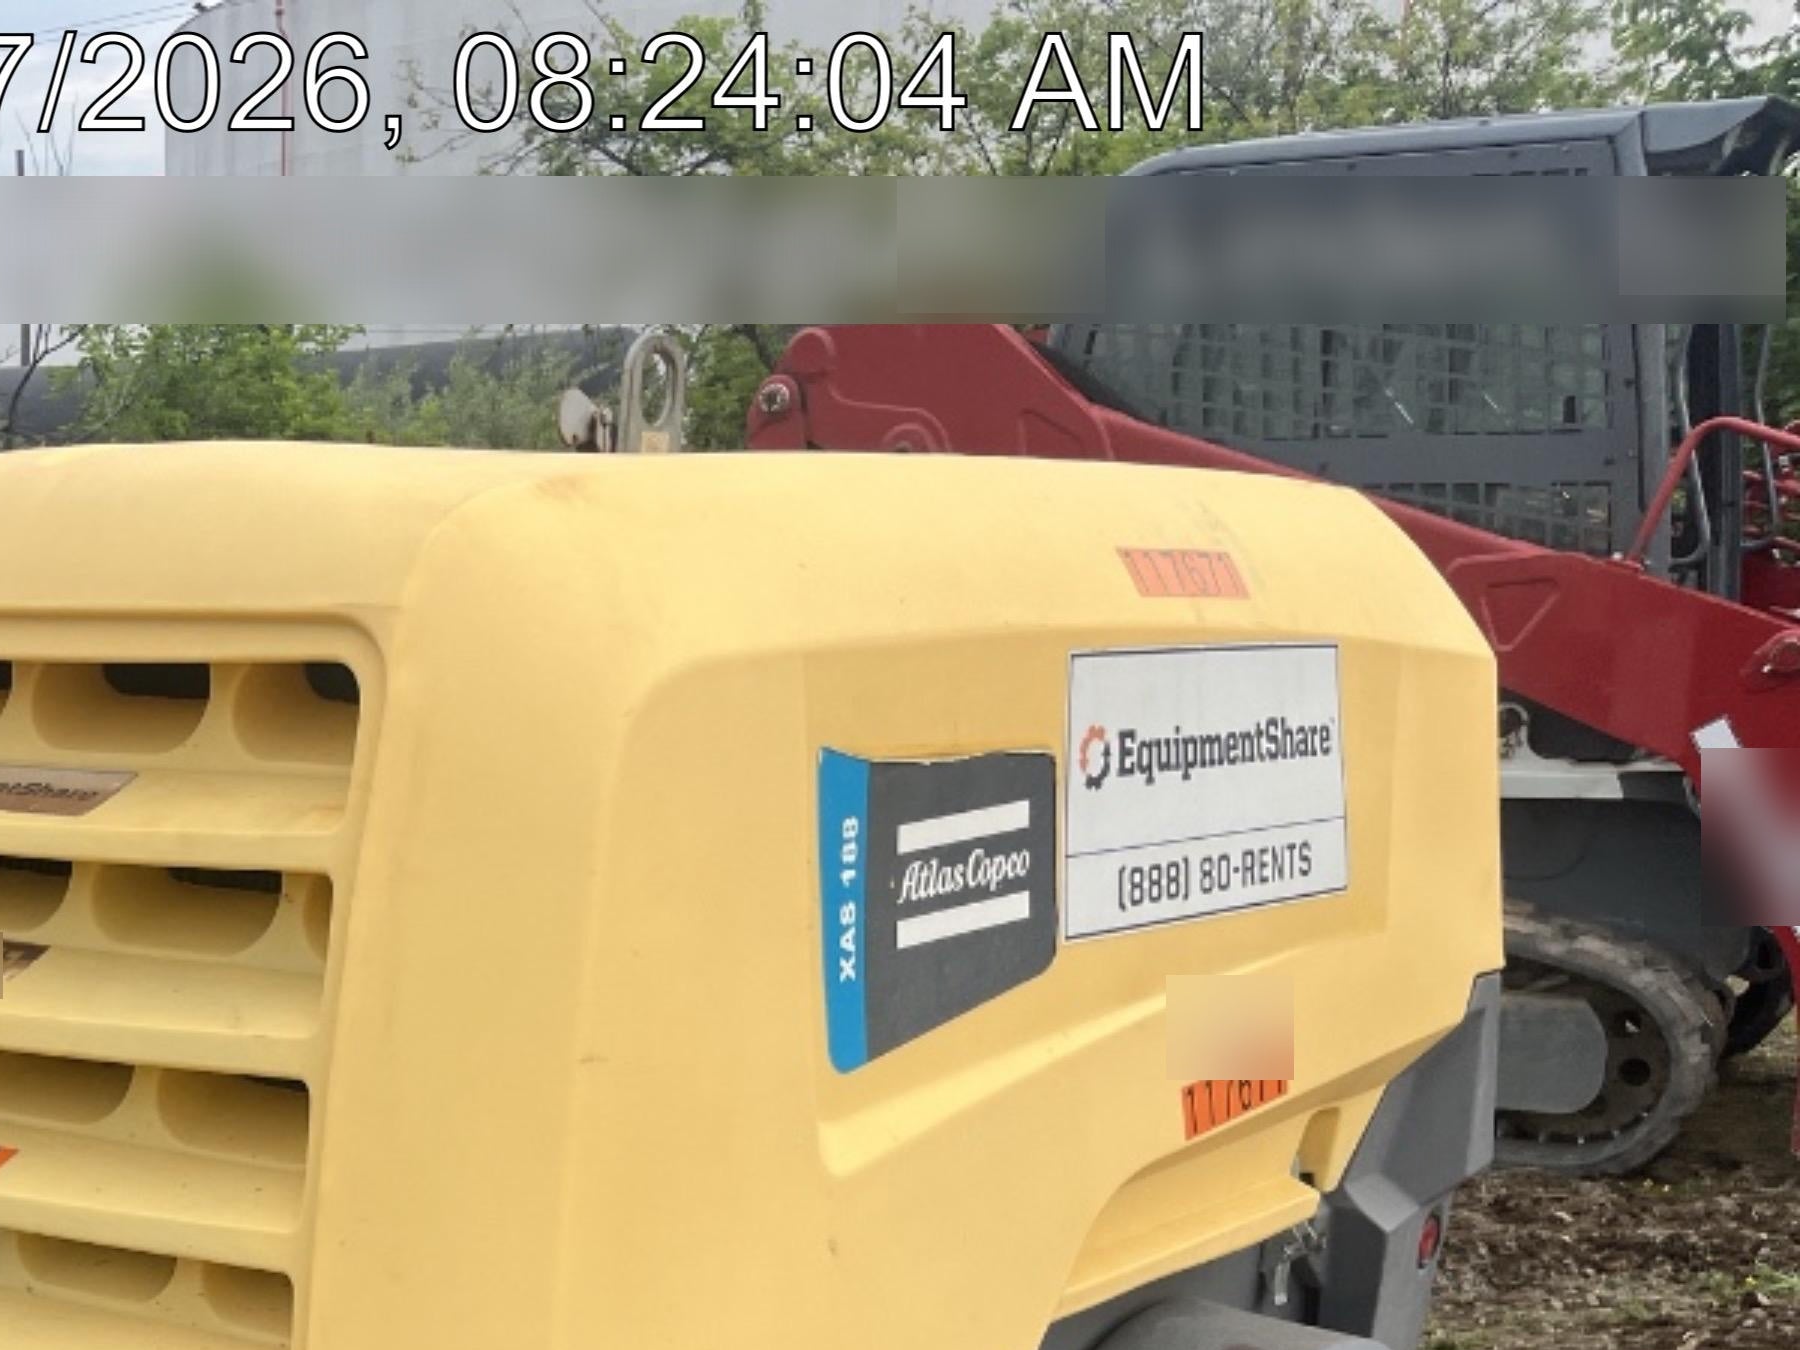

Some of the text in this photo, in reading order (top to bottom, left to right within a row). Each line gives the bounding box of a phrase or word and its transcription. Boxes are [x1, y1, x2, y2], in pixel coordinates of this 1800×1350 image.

[1122, 549, 1242, 597] 117671
[1117, 716, 1332, 786] EquipmentShare
[840, 816, 860, 888] 188
[897, 848, 1030, 904] Atlas Copco
[1118, 839, 1313, 912] (888) 80-RENTS
